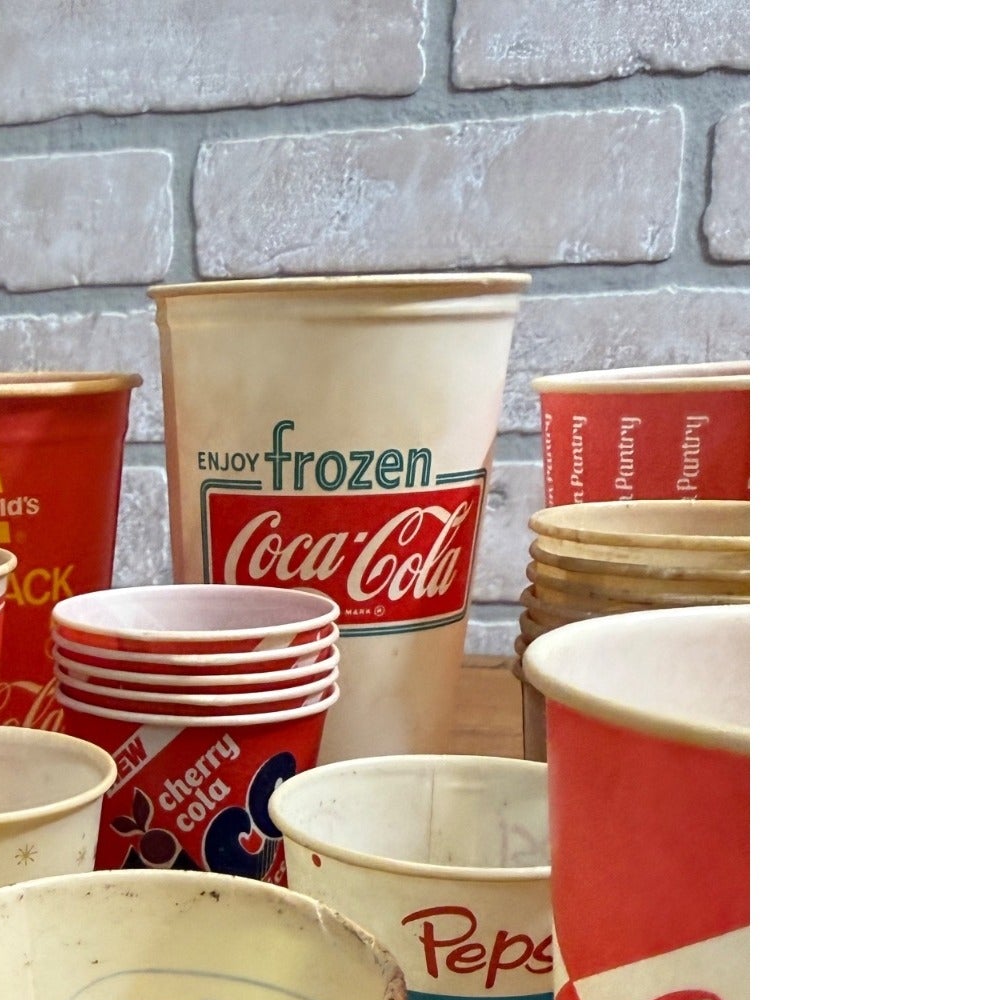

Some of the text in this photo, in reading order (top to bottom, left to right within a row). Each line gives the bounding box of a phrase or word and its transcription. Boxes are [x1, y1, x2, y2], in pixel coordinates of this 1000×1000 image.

[198, 420, 432, 491] ENJOY frozen
[615, 416, 642, 490] Pantry
[676, 415, 710, 491] Pantry
[6, 565, 74, 606] ACK
[224, 500, 474, 602] Coca-Cola
[110, 736, 148, 787] EW
[158, 733, 241, 812] cherry
[176, 778, 232, 833] cola
[401, 906, 553, 989] Peps
